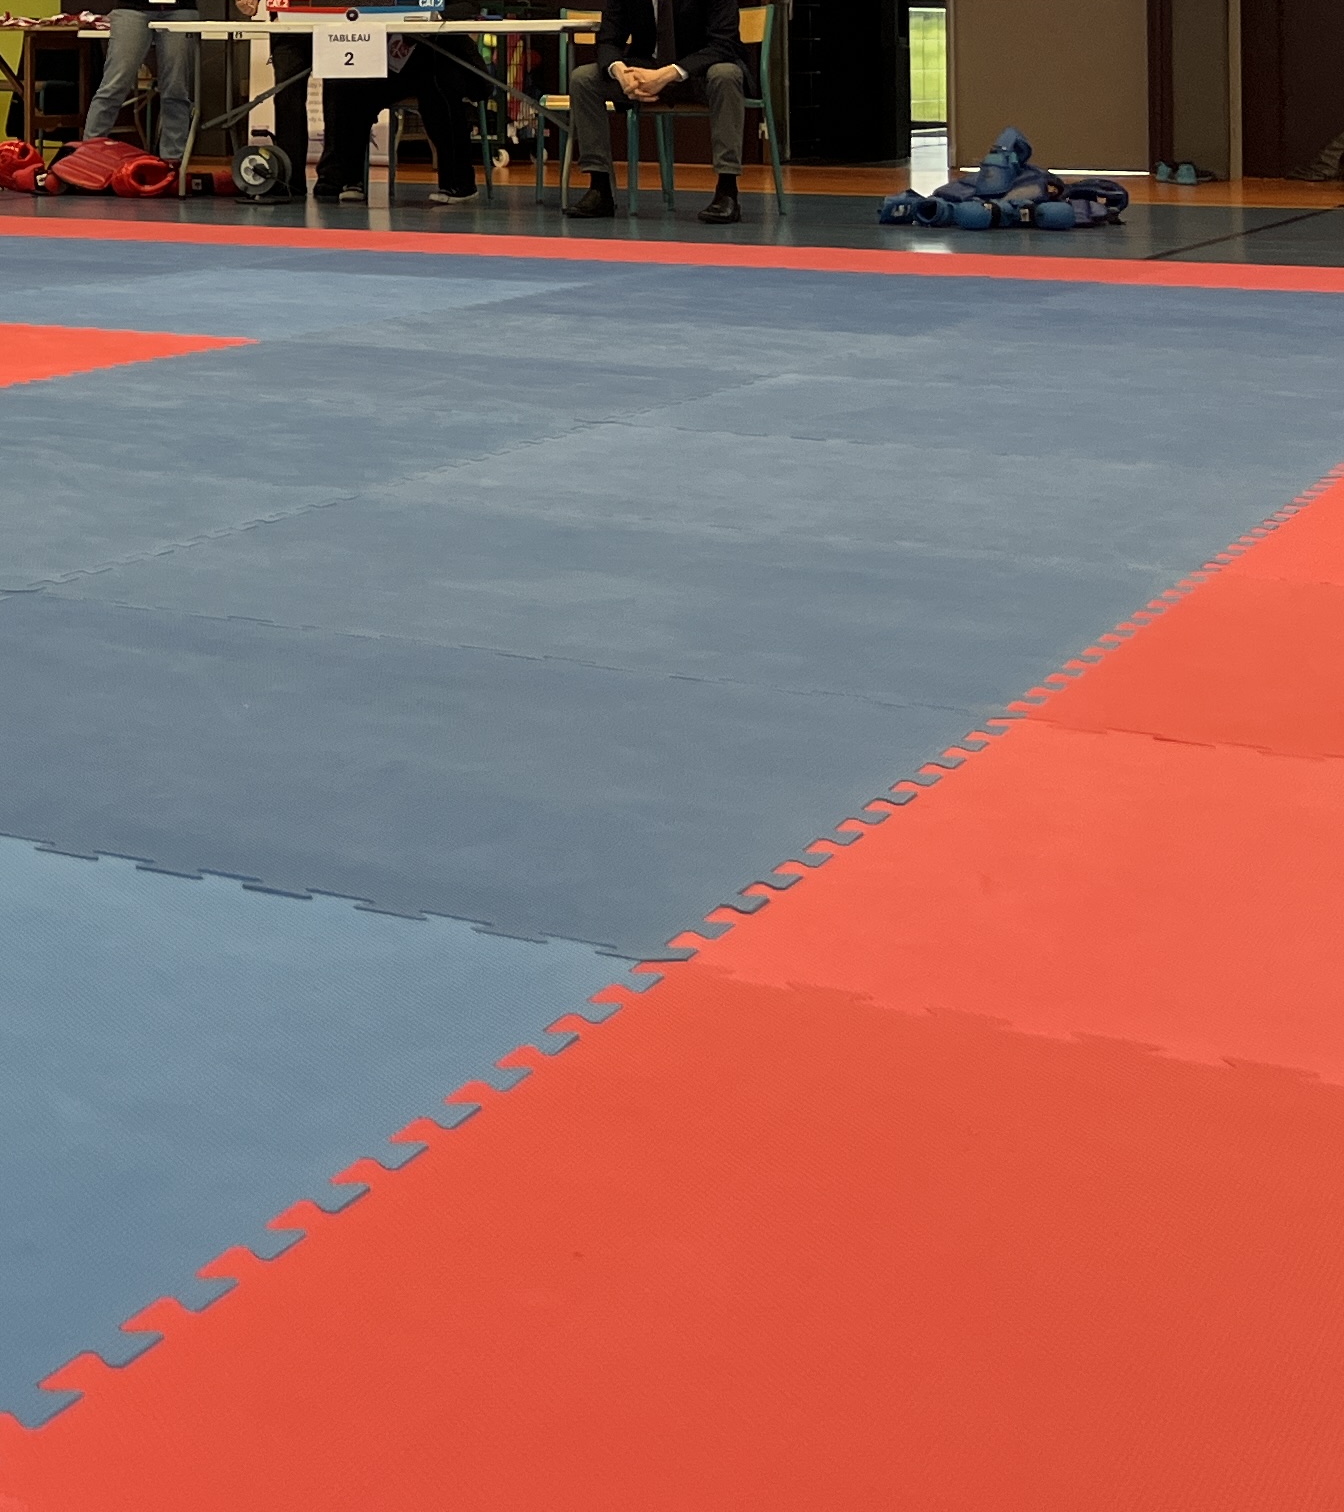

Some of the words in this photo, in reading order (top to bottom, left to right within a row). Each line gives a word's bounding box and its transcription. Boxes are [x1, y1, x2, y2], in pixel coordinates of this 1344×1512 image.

[267, 0, 289, 8] CAT.2
[328, 33, 370, 42] TABLEAU
[344, 52, 354, 66] 2
